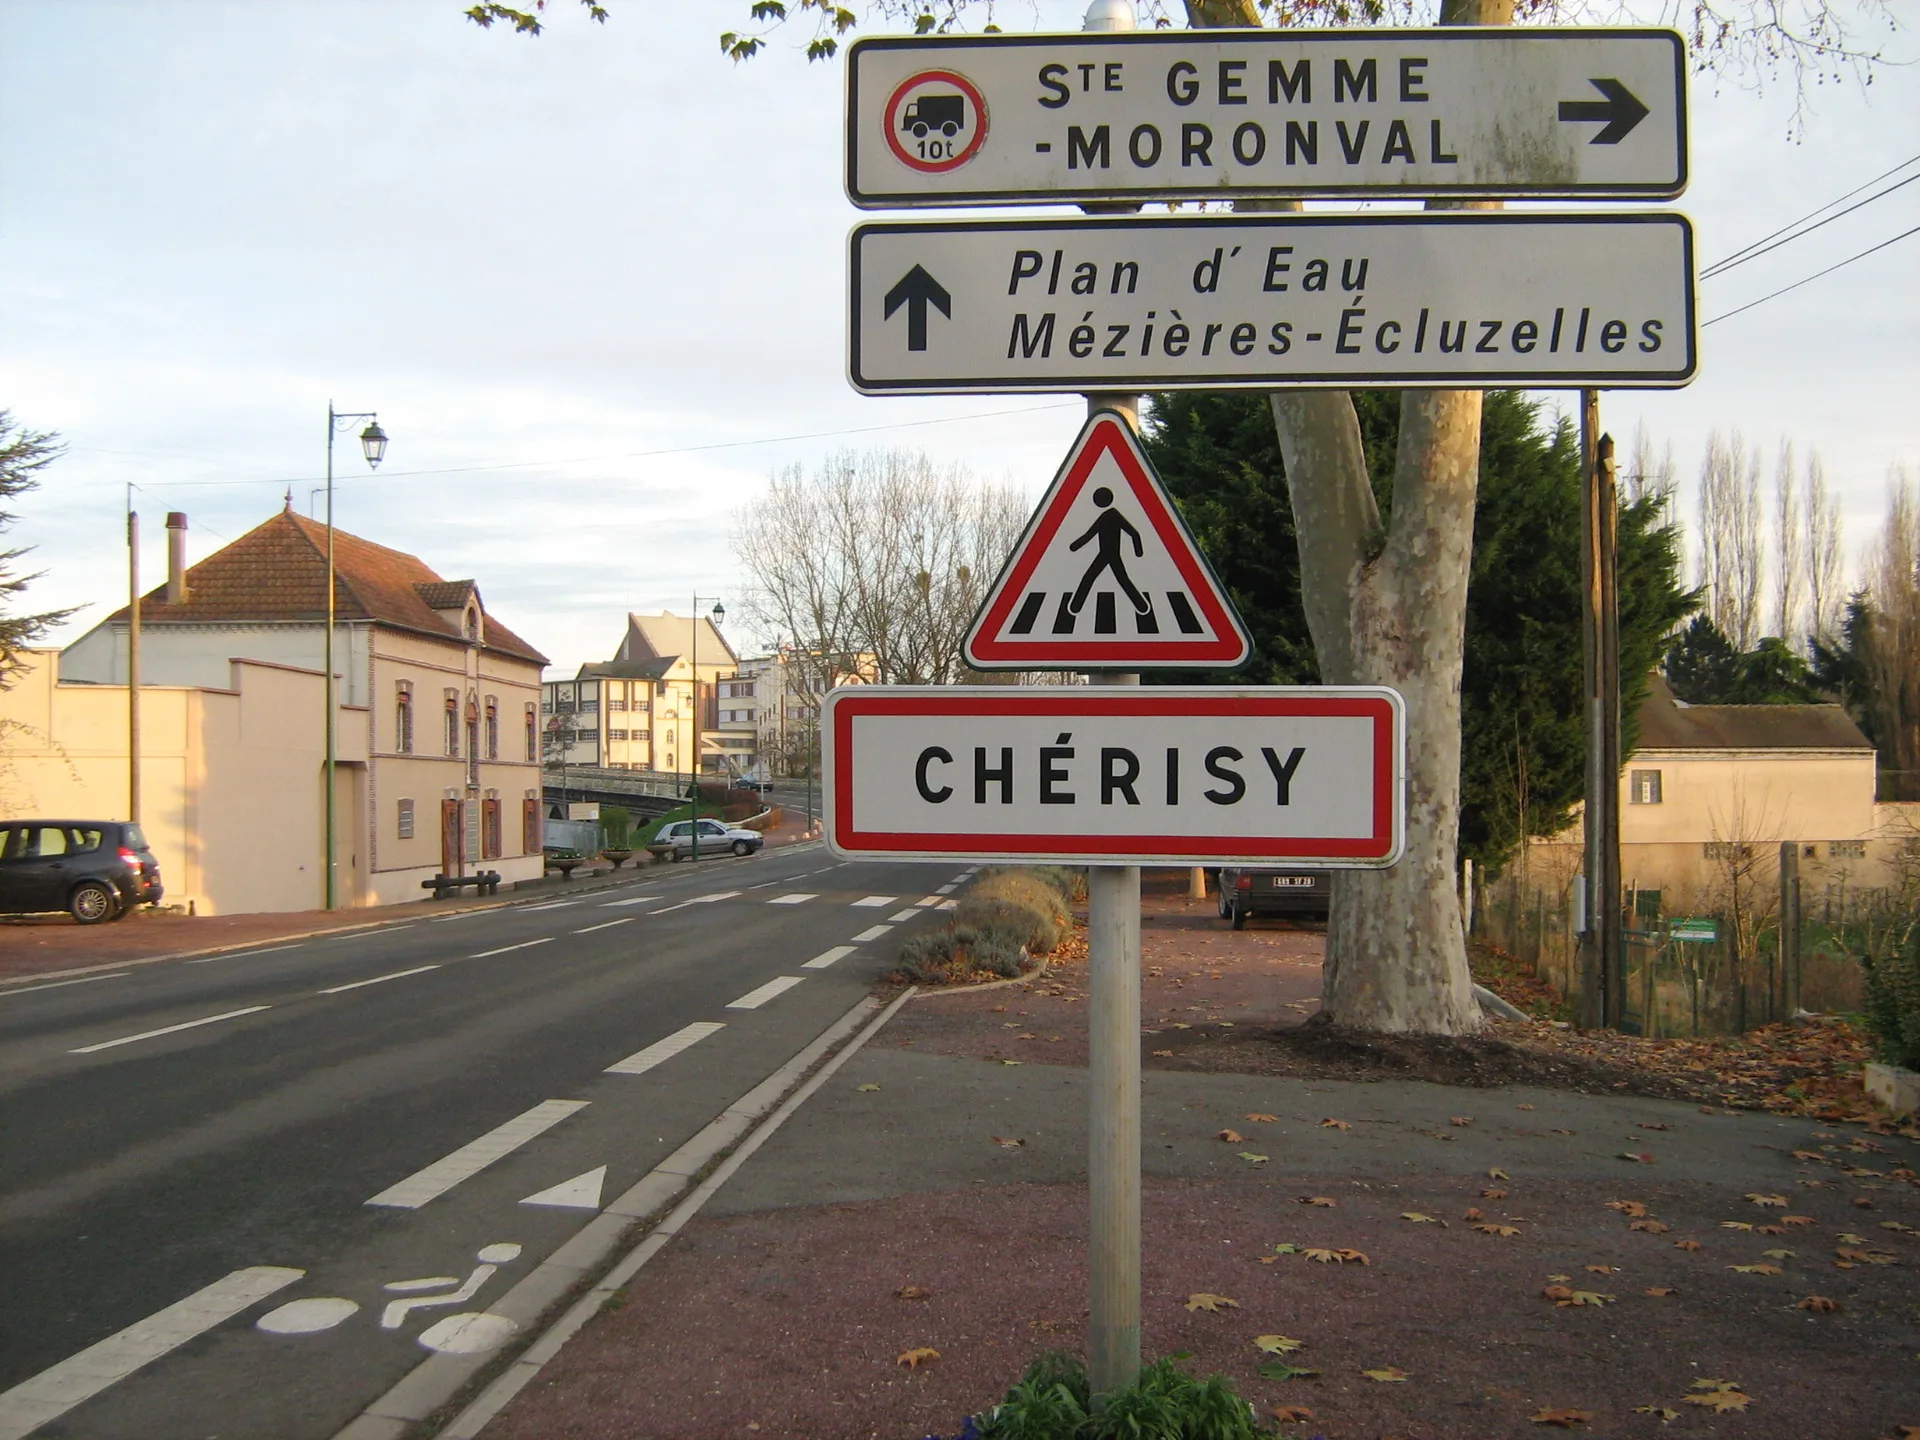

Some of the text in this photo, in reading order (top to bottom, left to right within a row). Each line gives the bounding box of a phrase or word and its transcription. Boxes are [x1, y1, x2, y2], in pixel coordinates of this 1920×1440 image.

[1166, 57, 1430, 107] GEMME
[917, 140, 954, 160] 10t
[1035, 118, 1460, 170] -MORONVAL
[1007, 249, 1139, 296] Plan
[1007, 295, 1664, 359] Mézières-Écluzelles
[914, 732, 1307, 806] CHÉRISY
